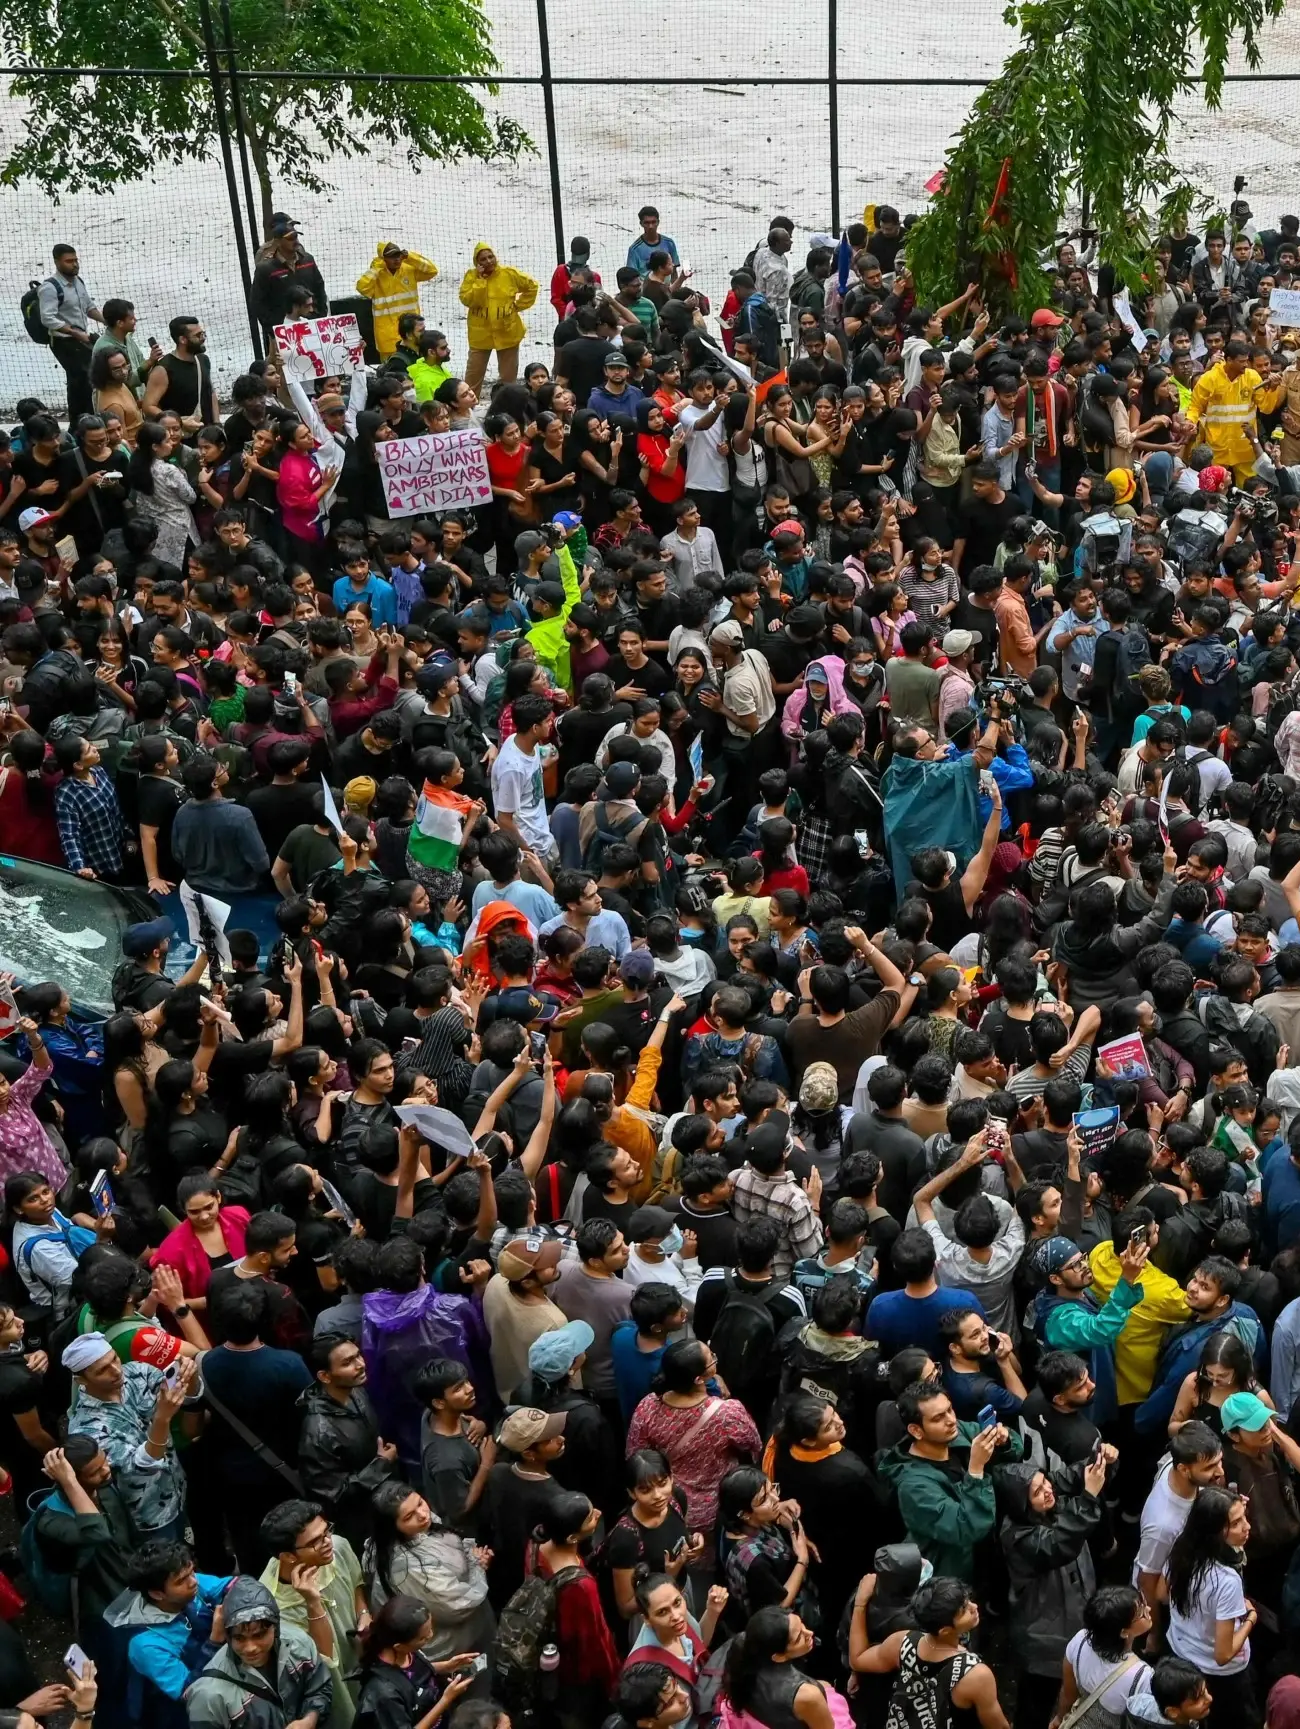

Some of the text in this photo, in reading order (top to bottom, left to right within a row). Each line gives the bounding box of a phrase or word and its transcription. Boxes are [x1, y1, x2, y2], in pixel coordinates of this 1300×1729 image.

[385, 432, 481, 462] BADDIES
[384, 448, 485, 478] ONLY WANT
[388, 465, 487, 496] AMBEDKARS
[406, 486, 475, 511] INDIA
[156, 1336, 176, 1365] adida
